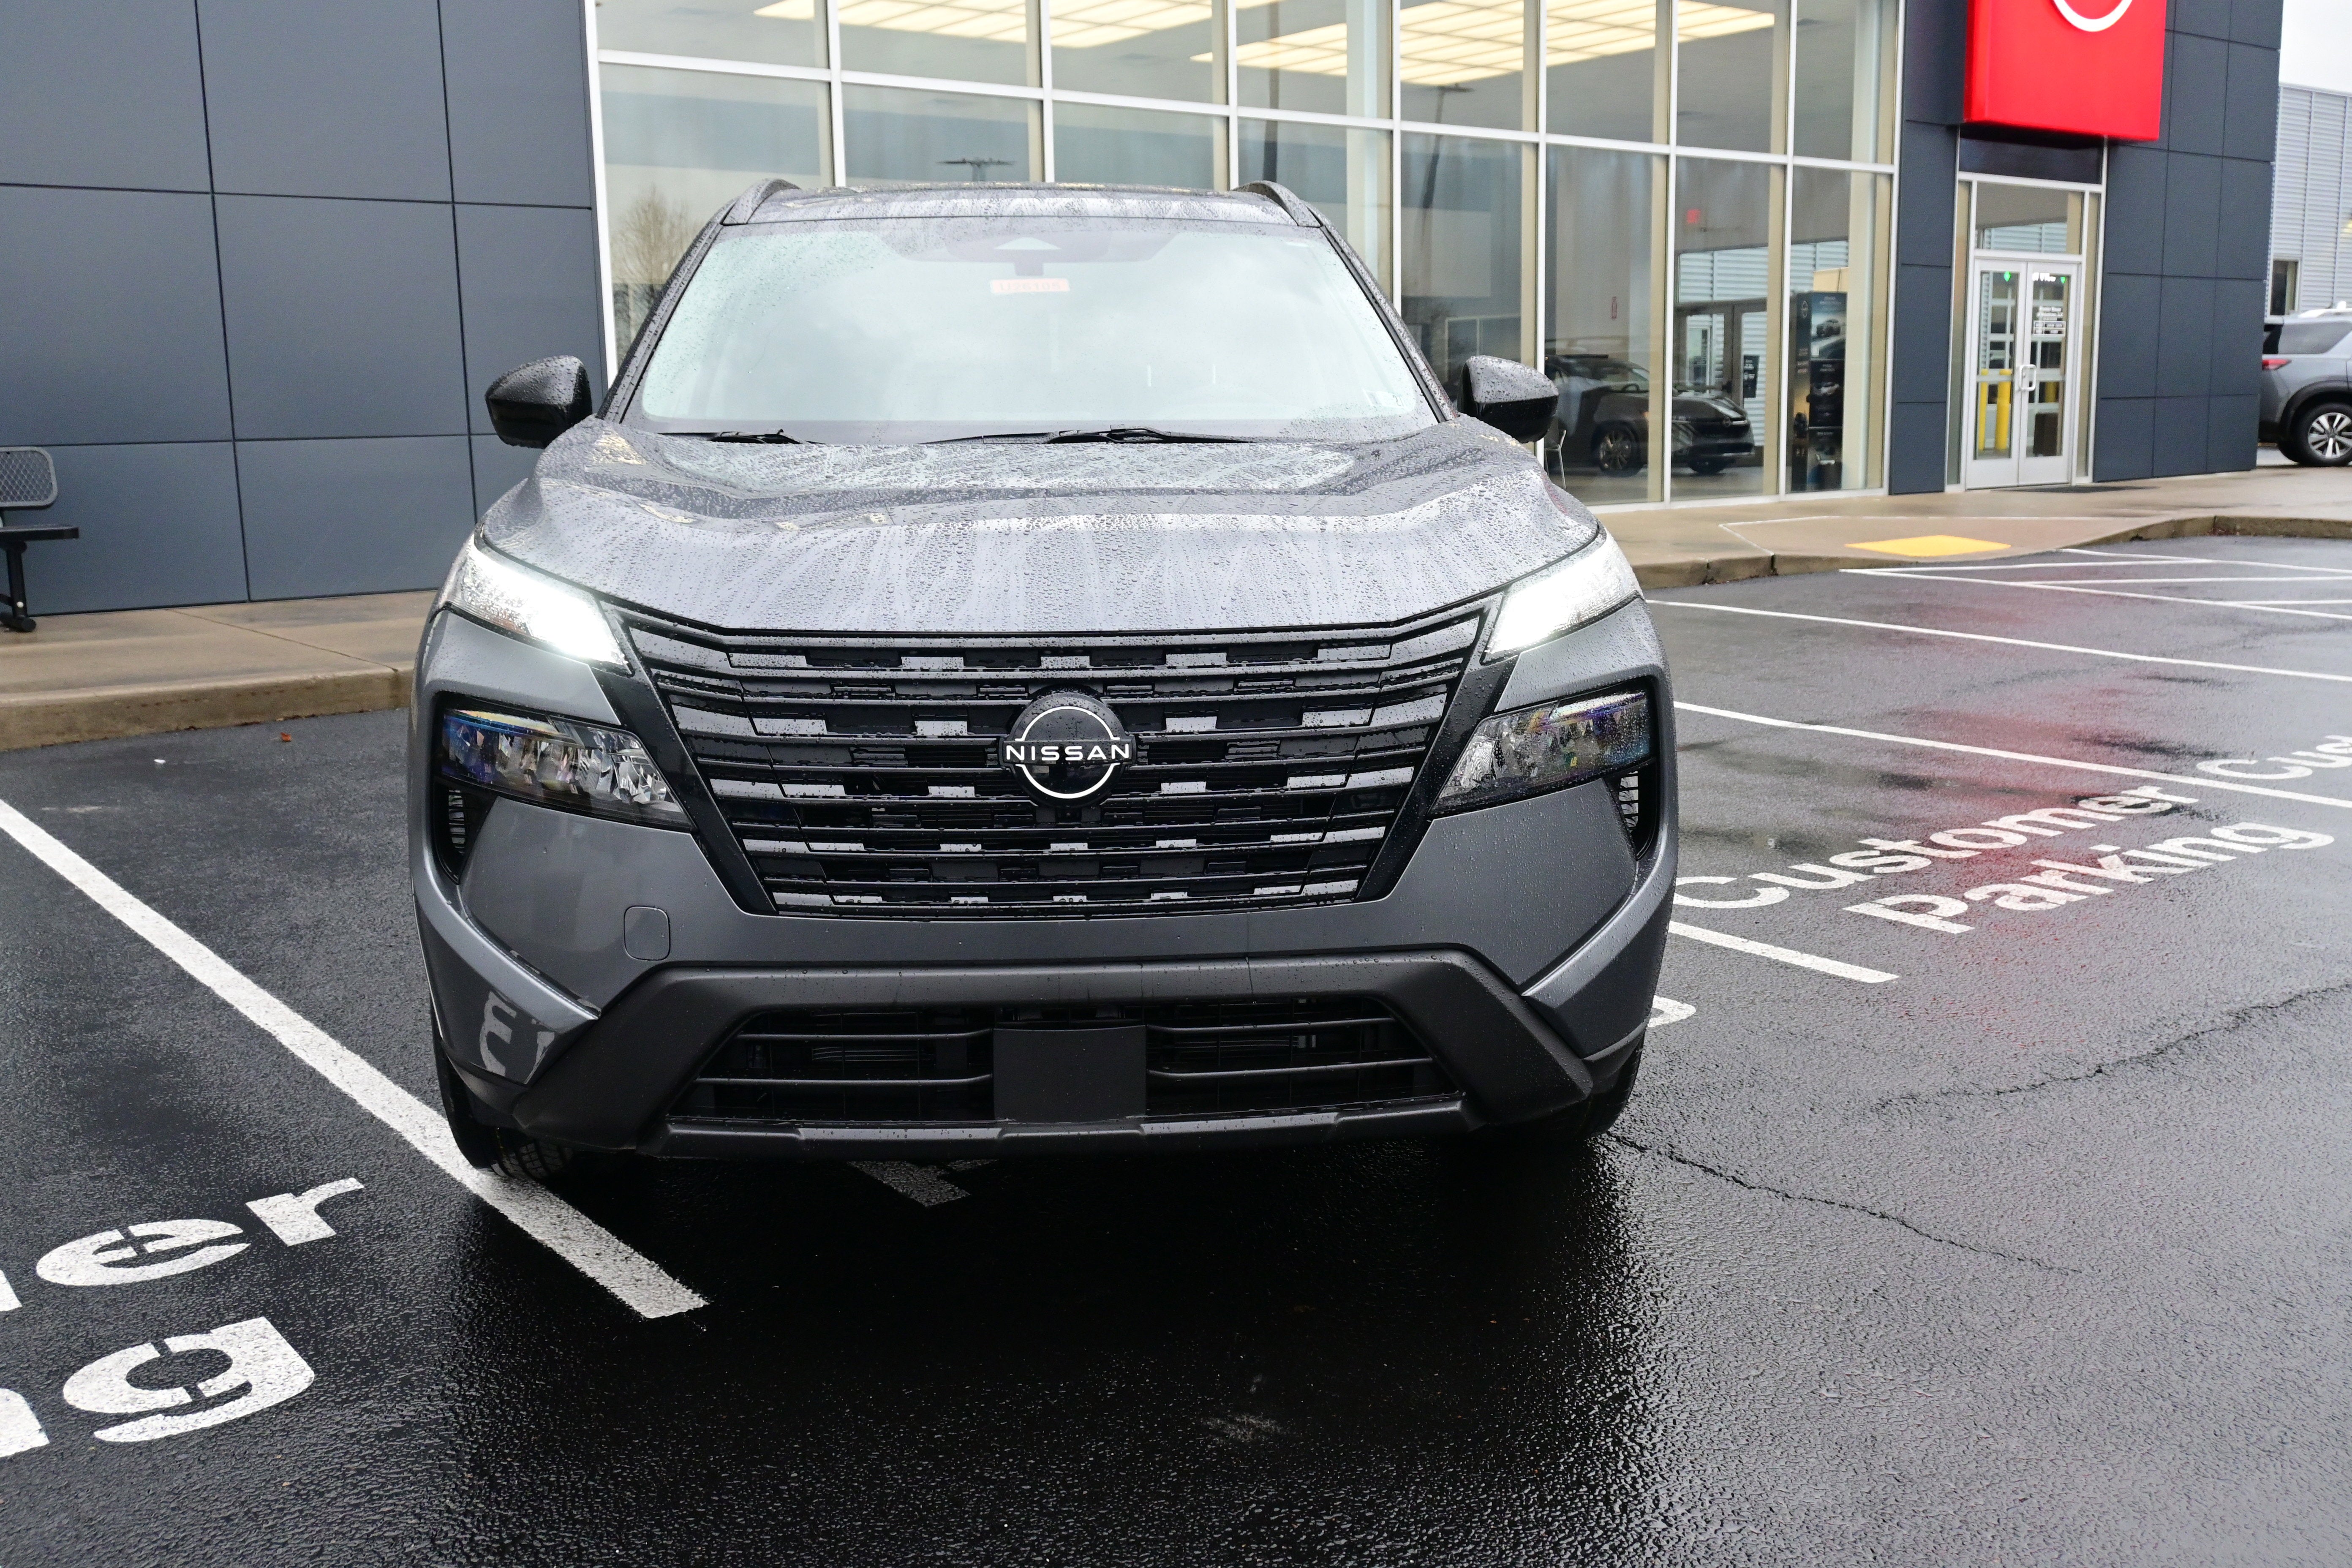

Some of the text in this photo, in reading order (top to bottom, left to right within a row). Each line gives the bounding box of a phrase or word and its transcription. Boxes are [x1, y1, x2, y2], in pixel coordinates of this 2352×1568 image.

[1006, 744, 1129, 761] NISSAN
[1674, 785, 2198, 909] Customer
[1844, 821, 2334, 934] Parking
